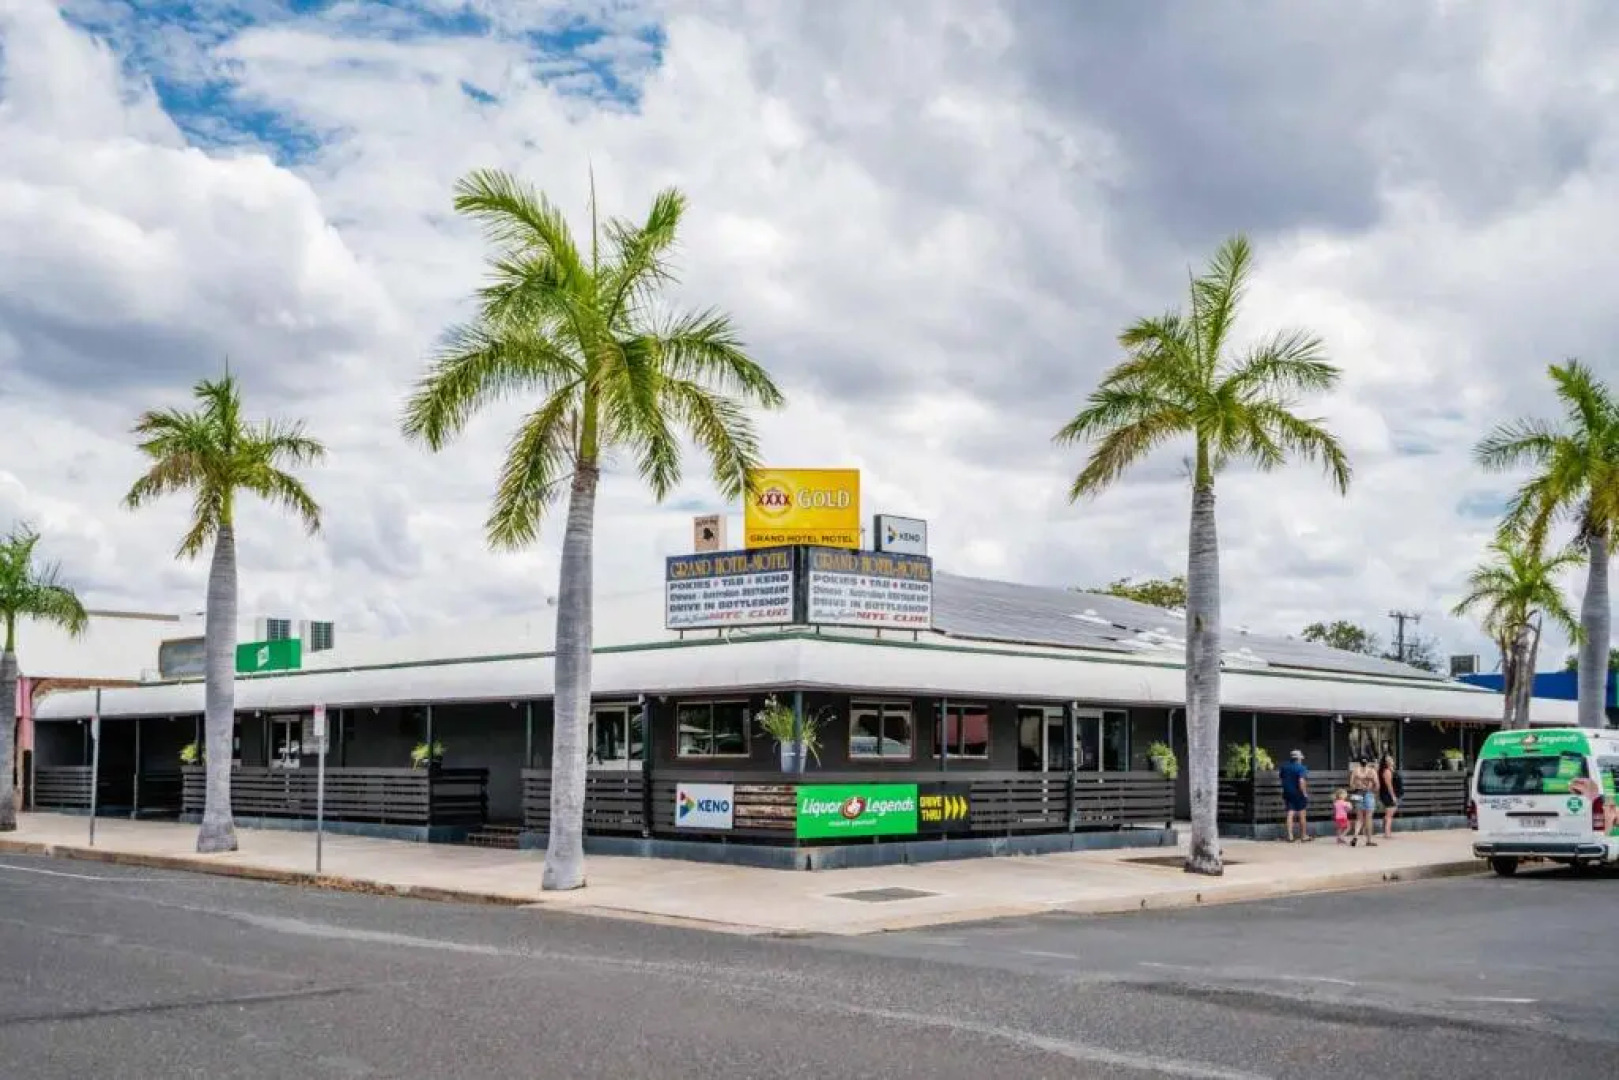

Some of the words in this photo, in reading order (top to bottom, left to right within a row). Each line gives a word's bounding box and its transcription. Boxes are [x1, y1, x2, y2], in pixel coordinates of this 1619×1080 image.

[756, 493, 792, 507] XXXX
[797, 489, 850, 508] GOLD
[750, 534, 785, 544] GRAND
[787, 534, 817, 543] HOTEL
[821, 534, 854, 543] MOTEL
[899, 531, 921, 543] KENO
[670, 560, 711, 579] GRAND
[669, 580, 711, 591] POKIES
[755, 573, 790, 583] KENO
[812, 573, 858, 585] POKIES
[900, 581, 929, 592] KENO
[669, 601, 702, 613] DRIVE
[704, 600, 716, 611] IN
[718, 596, 790, 610] BOTTLESHOP
[697, 798, 730, 813] KENO
[801, 797, 841, 817] Liquor
[865, 796, 915, 816] Legends
[919, 796, 942, 808] DRIVE
[921, 809, 942, 821] THRU
